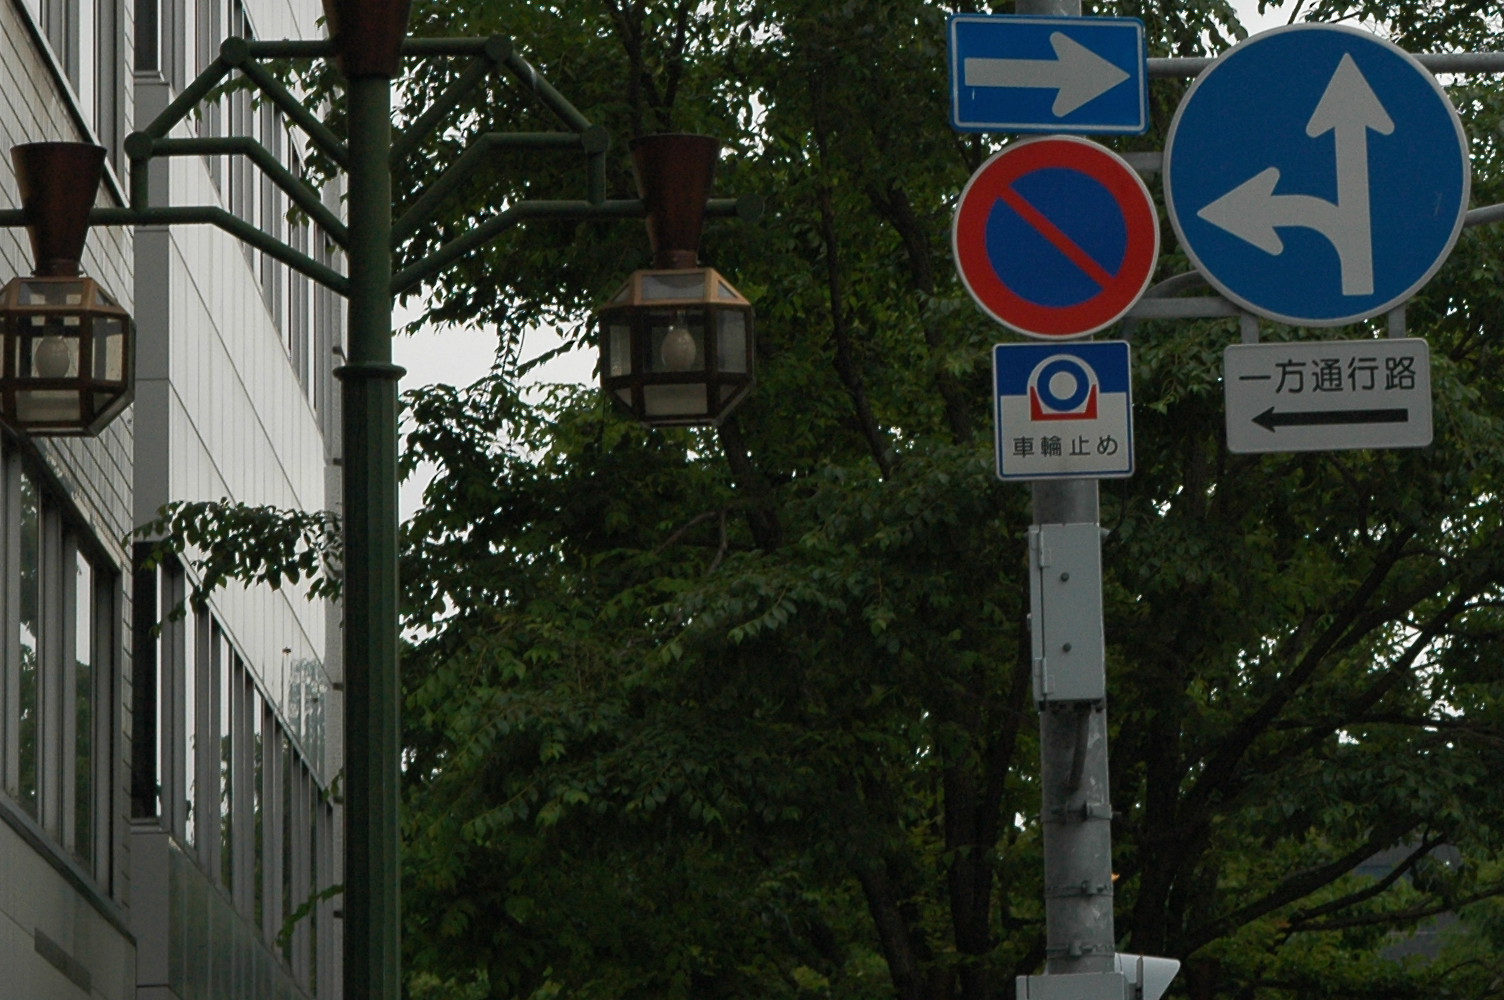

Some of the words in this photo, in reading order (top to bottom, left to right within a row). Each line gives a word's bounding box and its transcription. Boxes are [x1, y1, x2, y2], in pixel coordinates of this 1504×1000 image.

[1238, 356, 1417, 394] 一方通行路
[1012, 434, 1119, 460] 車輪止め
